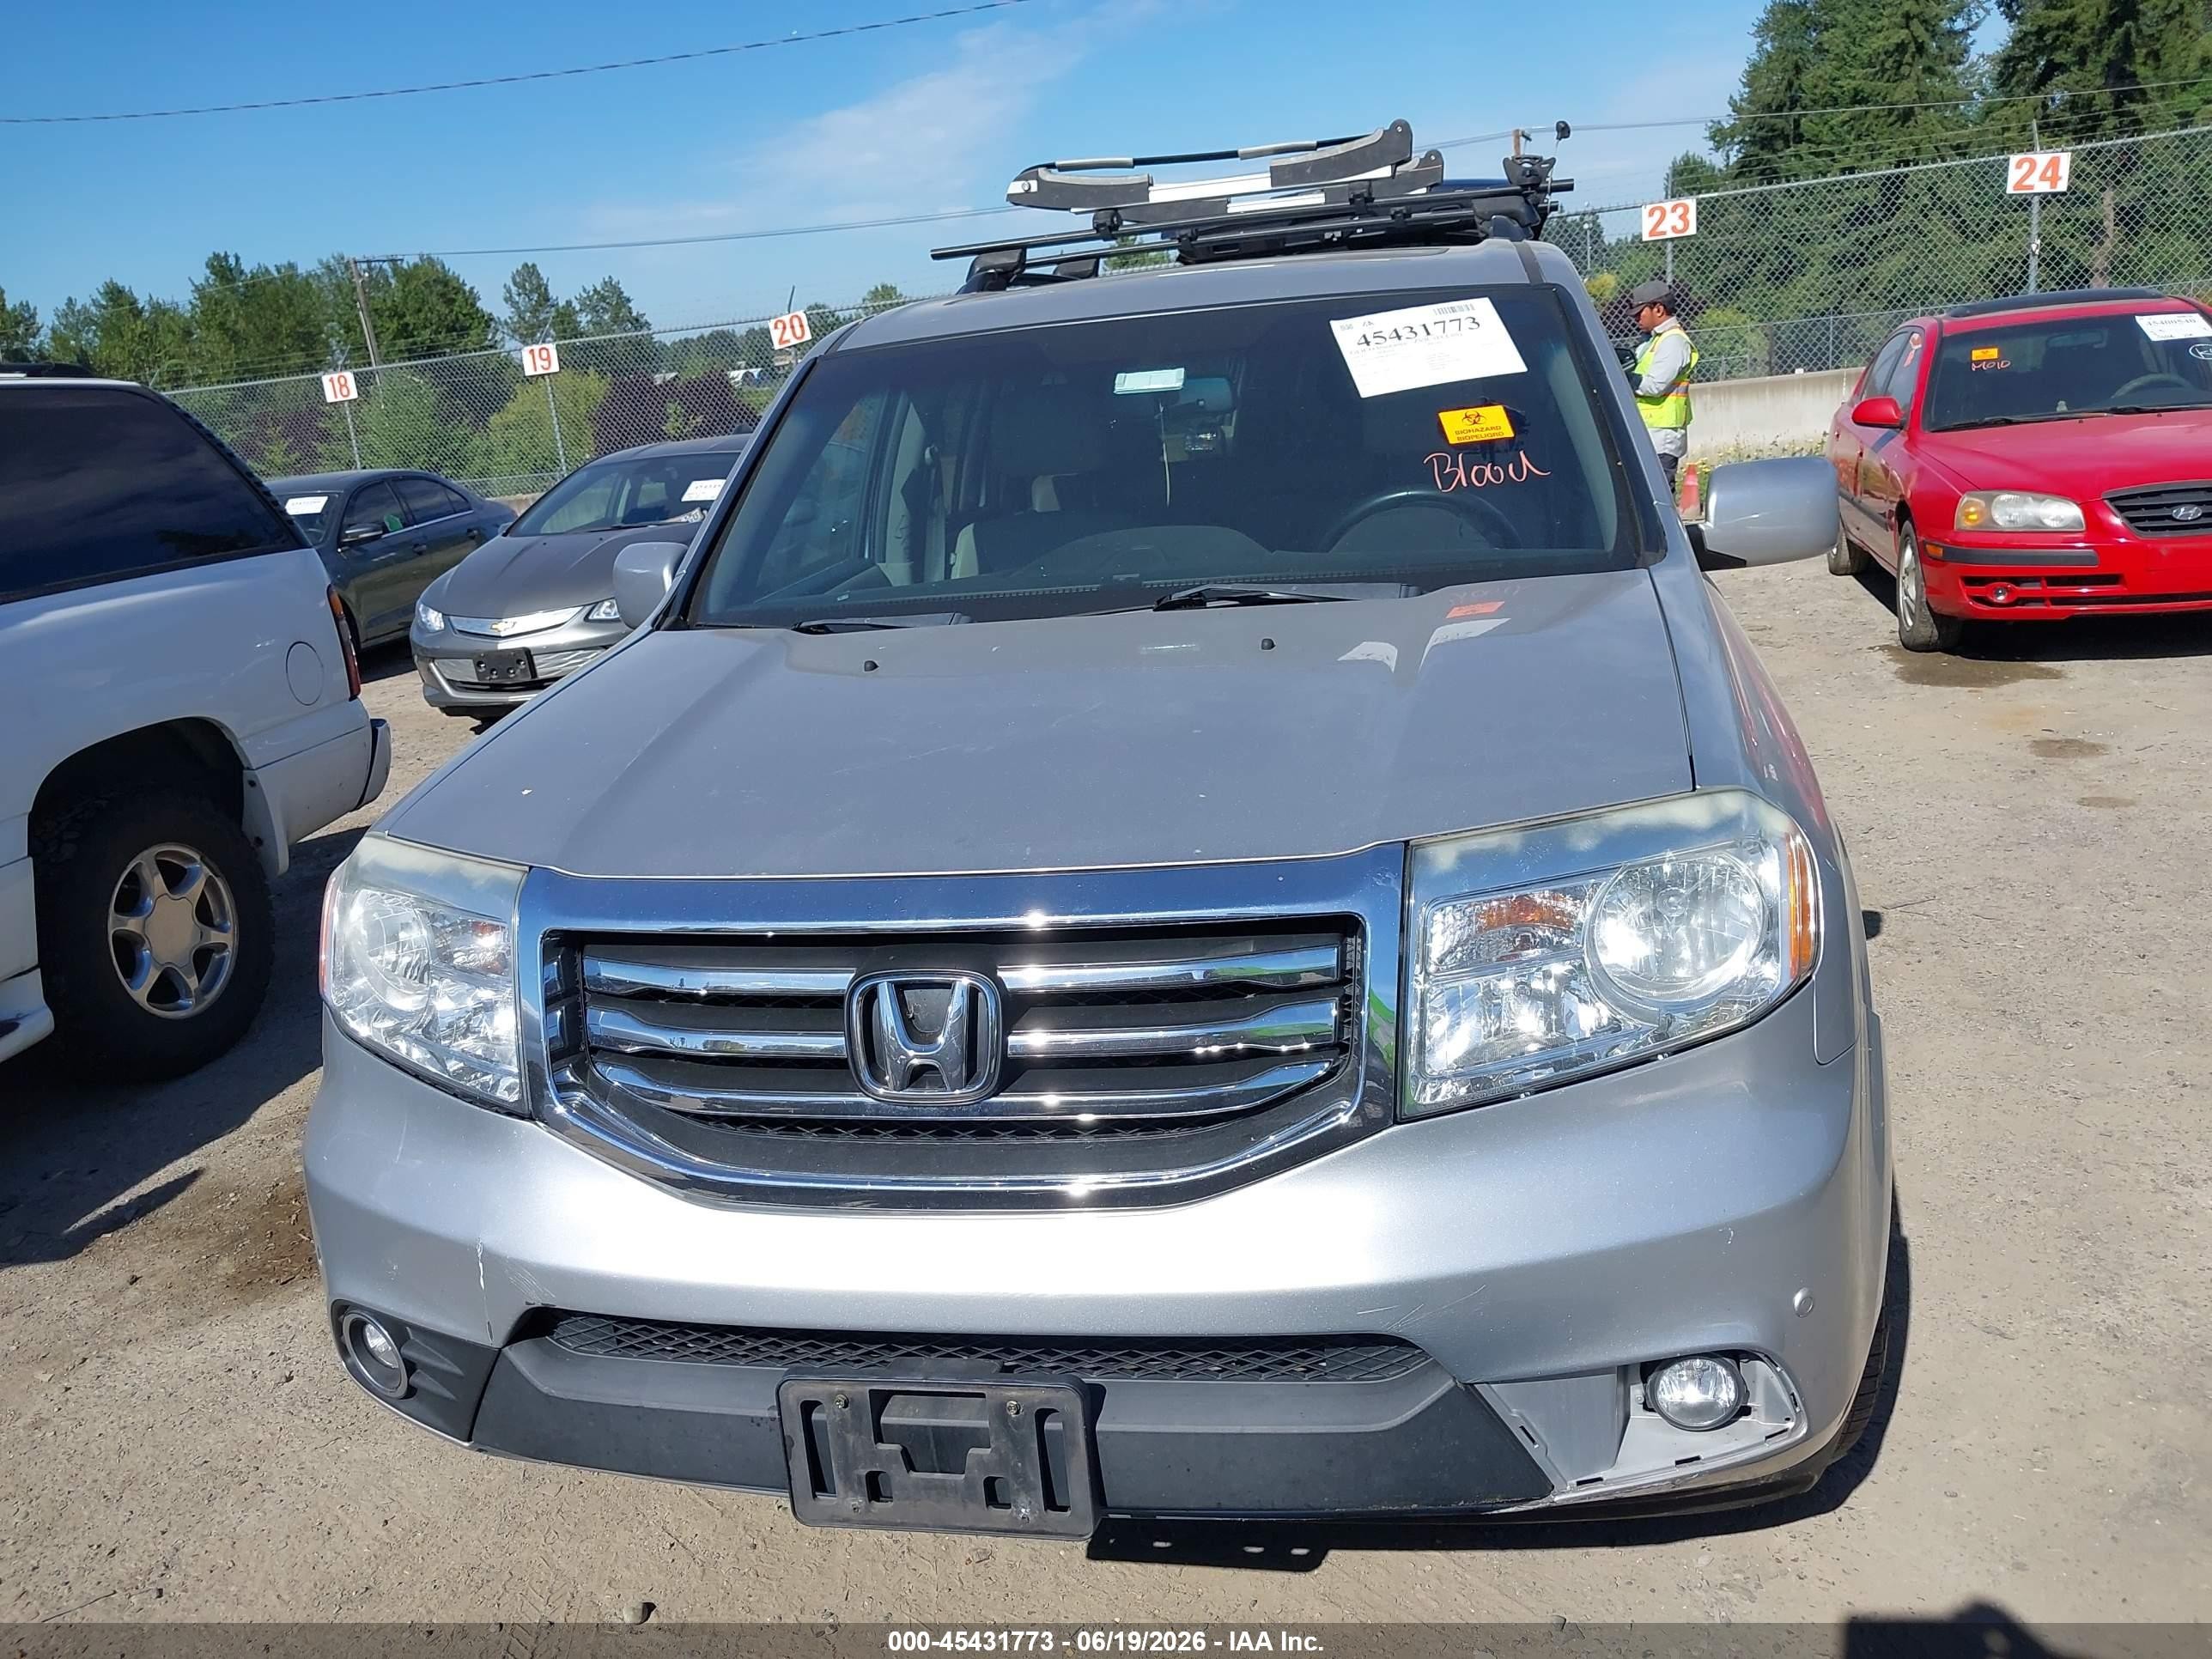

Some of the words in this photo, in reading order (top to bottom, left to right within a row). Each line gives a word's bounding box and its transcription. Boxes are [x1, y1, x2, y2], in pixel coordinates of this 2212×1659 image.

[2012, 155, 2063, 191] 24
[1648, 202, 1691, 238] 23
[774, 315, 805, 345] 20
[1356, 315, 1481, 348] 45431773
[528, 347, 551, 372] 19
[329, 374, 350, 398] 18
[1455, 426, 1502, 435] BIOHAZARD
